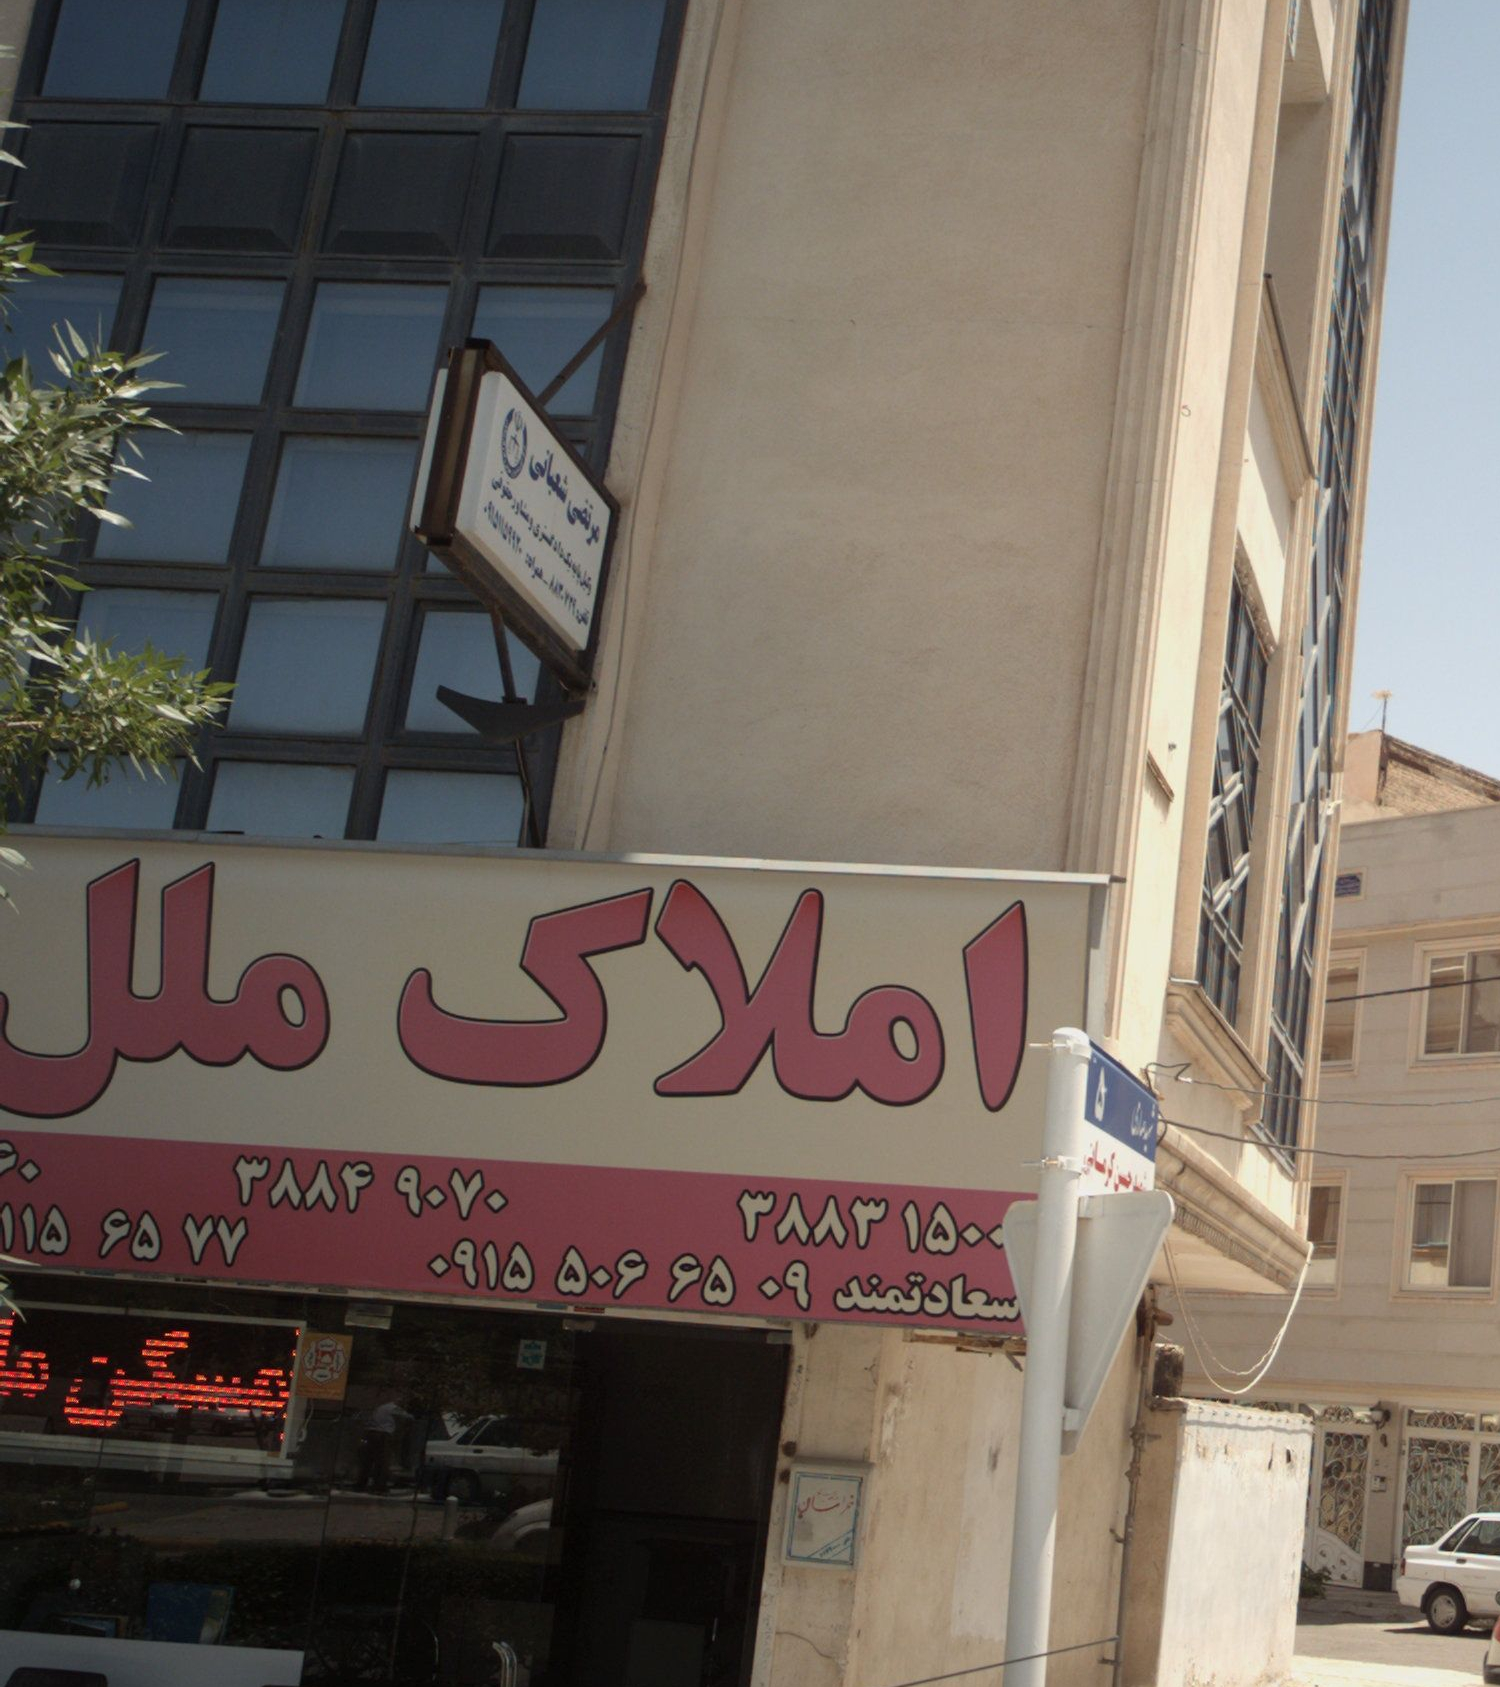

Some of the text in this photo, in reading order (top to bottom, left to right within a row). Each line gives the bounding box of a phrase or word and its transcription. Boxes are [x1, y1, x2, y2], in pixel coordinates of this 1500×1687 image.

[528, 450, 601, 546] مرتضی شعبانی
[532, 523, 565, 558] دادگستری
[0, 858, 1029, 1119] املاک ملل
[233, 1155, 508, 1220] ۳۸۸۴ ۹۰۷۰
[737, 1189, 1004, 1255] ۳۸۸۳ ۱۵۰۰
[99, 1208, 162, 1262] ۶۵
[182, 1213, 248, 1267] ۷۷
[429, 1238, 1021, 1323] سعادتمند ۰۹۱۵ ۵۰۶ ۶۵ ۰۹
[64, 1330, 291, 1428] مسکن
